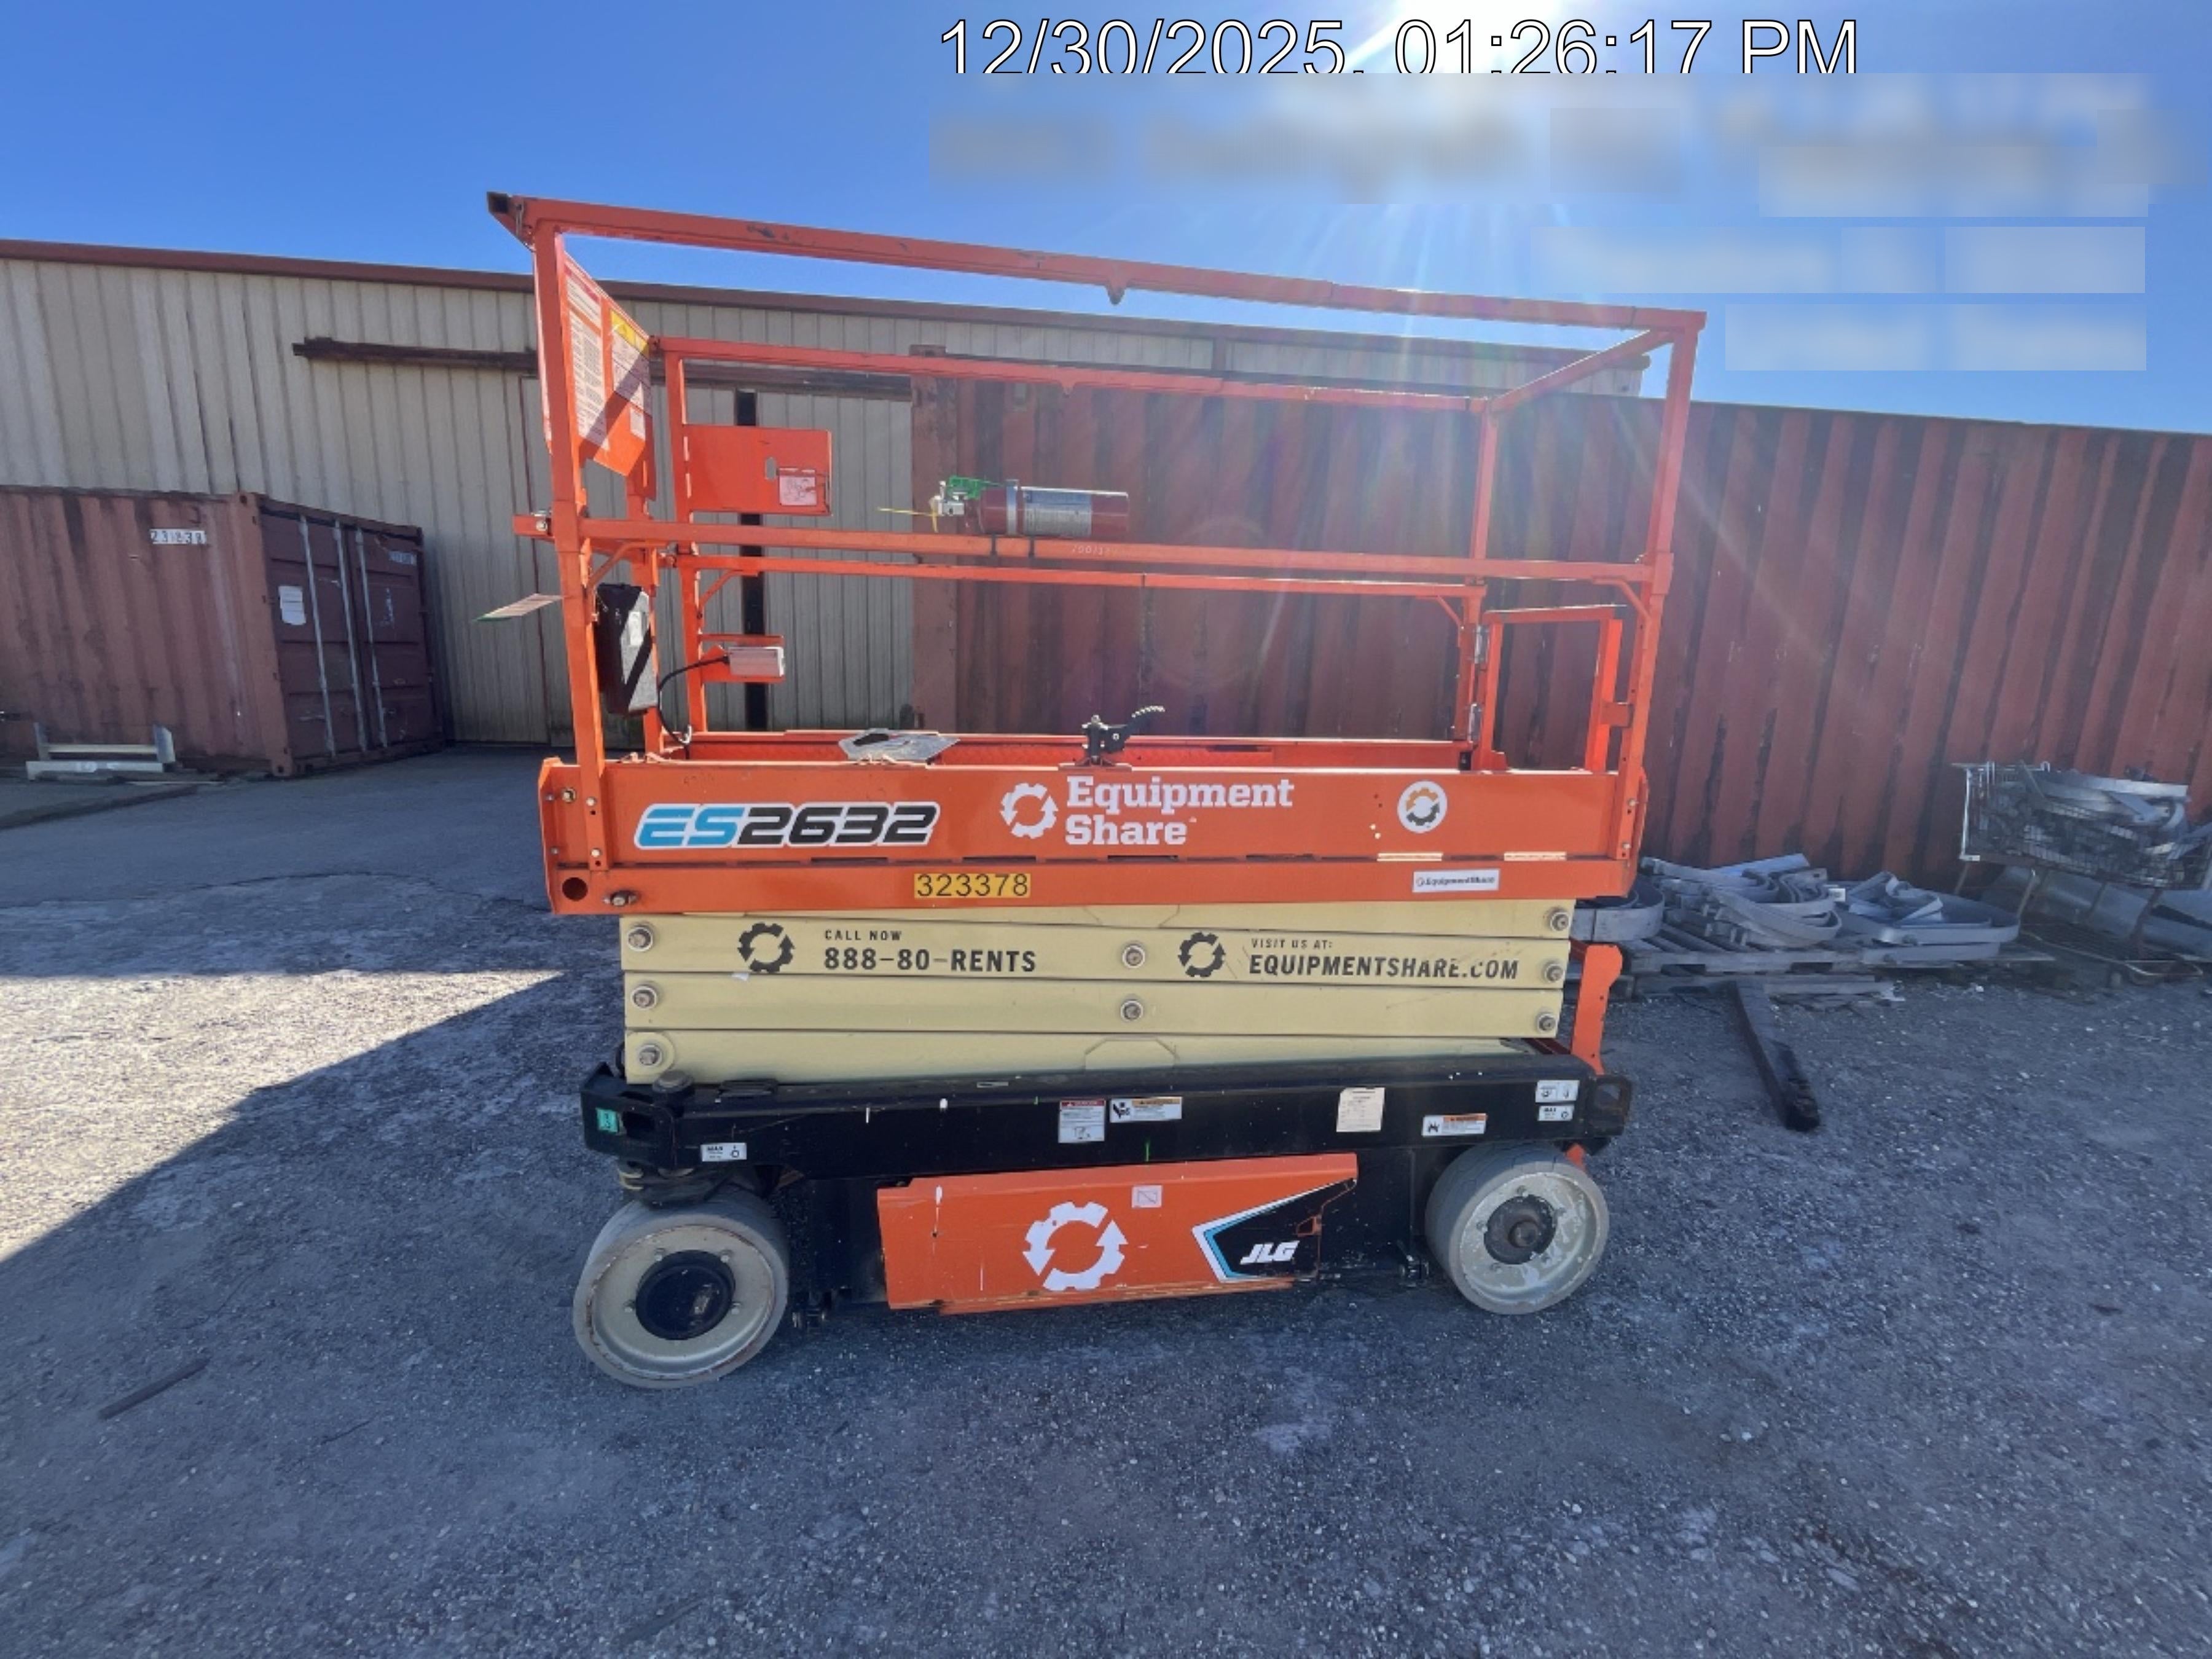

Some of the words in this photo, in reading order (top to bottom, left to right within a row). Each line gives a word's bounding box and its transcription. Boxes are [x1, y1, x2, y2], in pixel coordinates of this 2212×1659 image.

[1066, 776, 1295, 814] Equipment
[635, 804, 939, 847] ES2632
[1065, 815, 1187, 845] Share
[917, 873, 1028, 896] 323378
[825, 930, 861, 941] CALL
[869, 930, 901, 941] NOW
[1251, 938, 1285, 948] VISIT
[1292, 939, 1308, 949] US
[1314, 939, 1332, 949] AT:
[824, 947, 1037, 972] 888-80-RENTS
[1249, 954, 1518, 979] EQUIPMENTSHARE.COM
[1240, 1241, 1300, 1265] JLG
